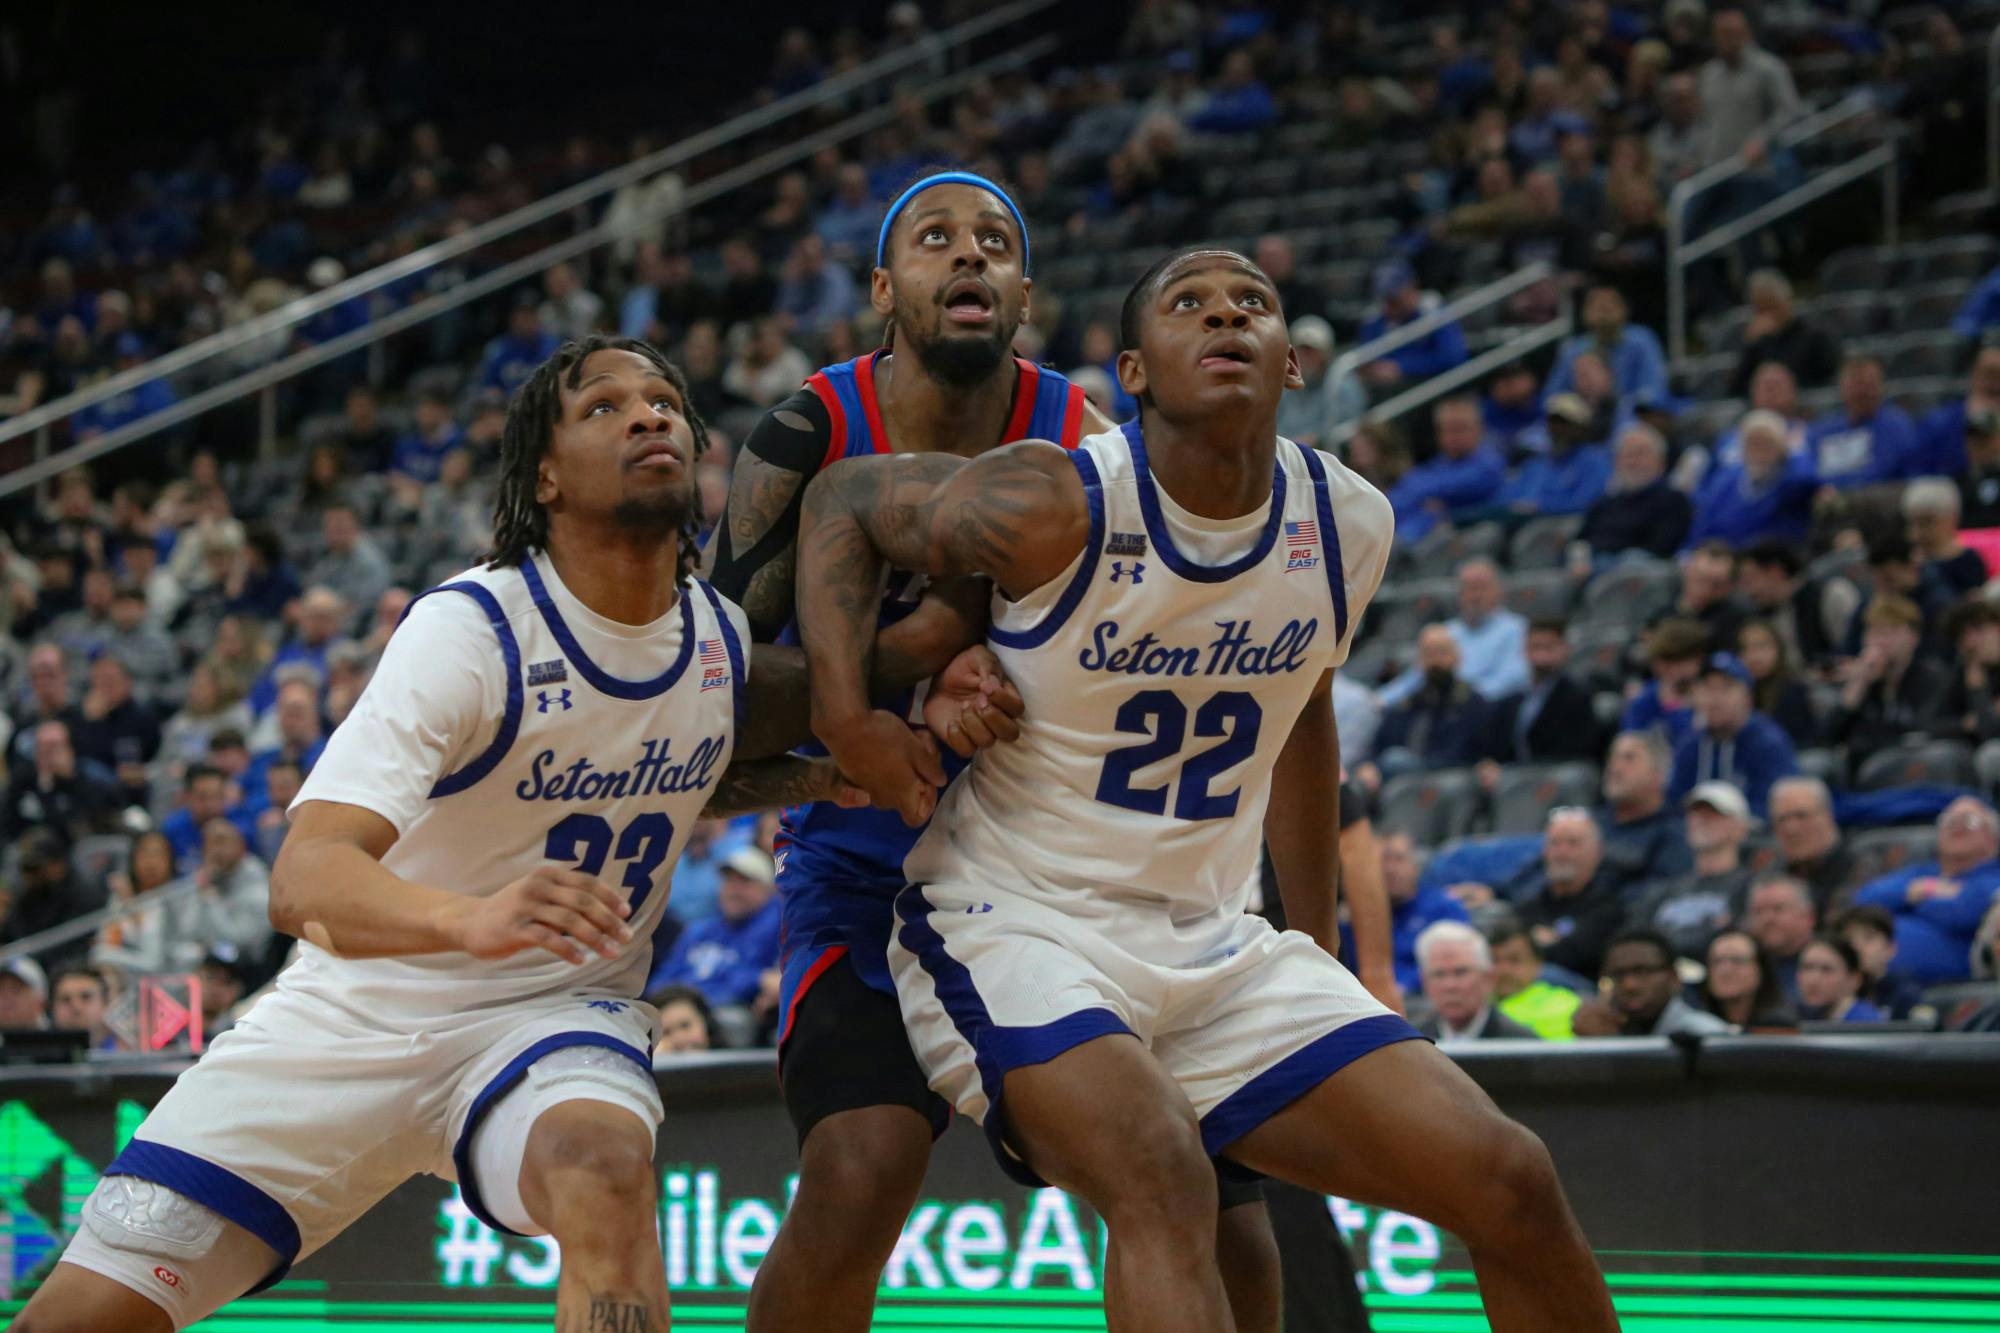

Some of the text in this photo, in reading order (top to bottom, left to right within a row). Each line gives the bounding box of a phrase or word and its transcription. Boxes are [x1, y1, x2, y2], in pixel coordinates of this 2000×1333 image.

[1111, 532, 1147, 545] BE THE
[1105, 543, 1147, 556] CHANGE
[1290, 549, 1312, 559] BIG
[1287, 558, 1320, 568] EAST
[1079, 617, 1318, 677] Seton Hall
[528, 659, 565, 674] BE THE
[704, 667, 725, 678] BIG
[528, 670, 568, 687] CHANGE
[701, 676, 730, 688] EAST
[1095, 689, 1263, 821] 22
[516, 735, 725, 801] Seton Hall
